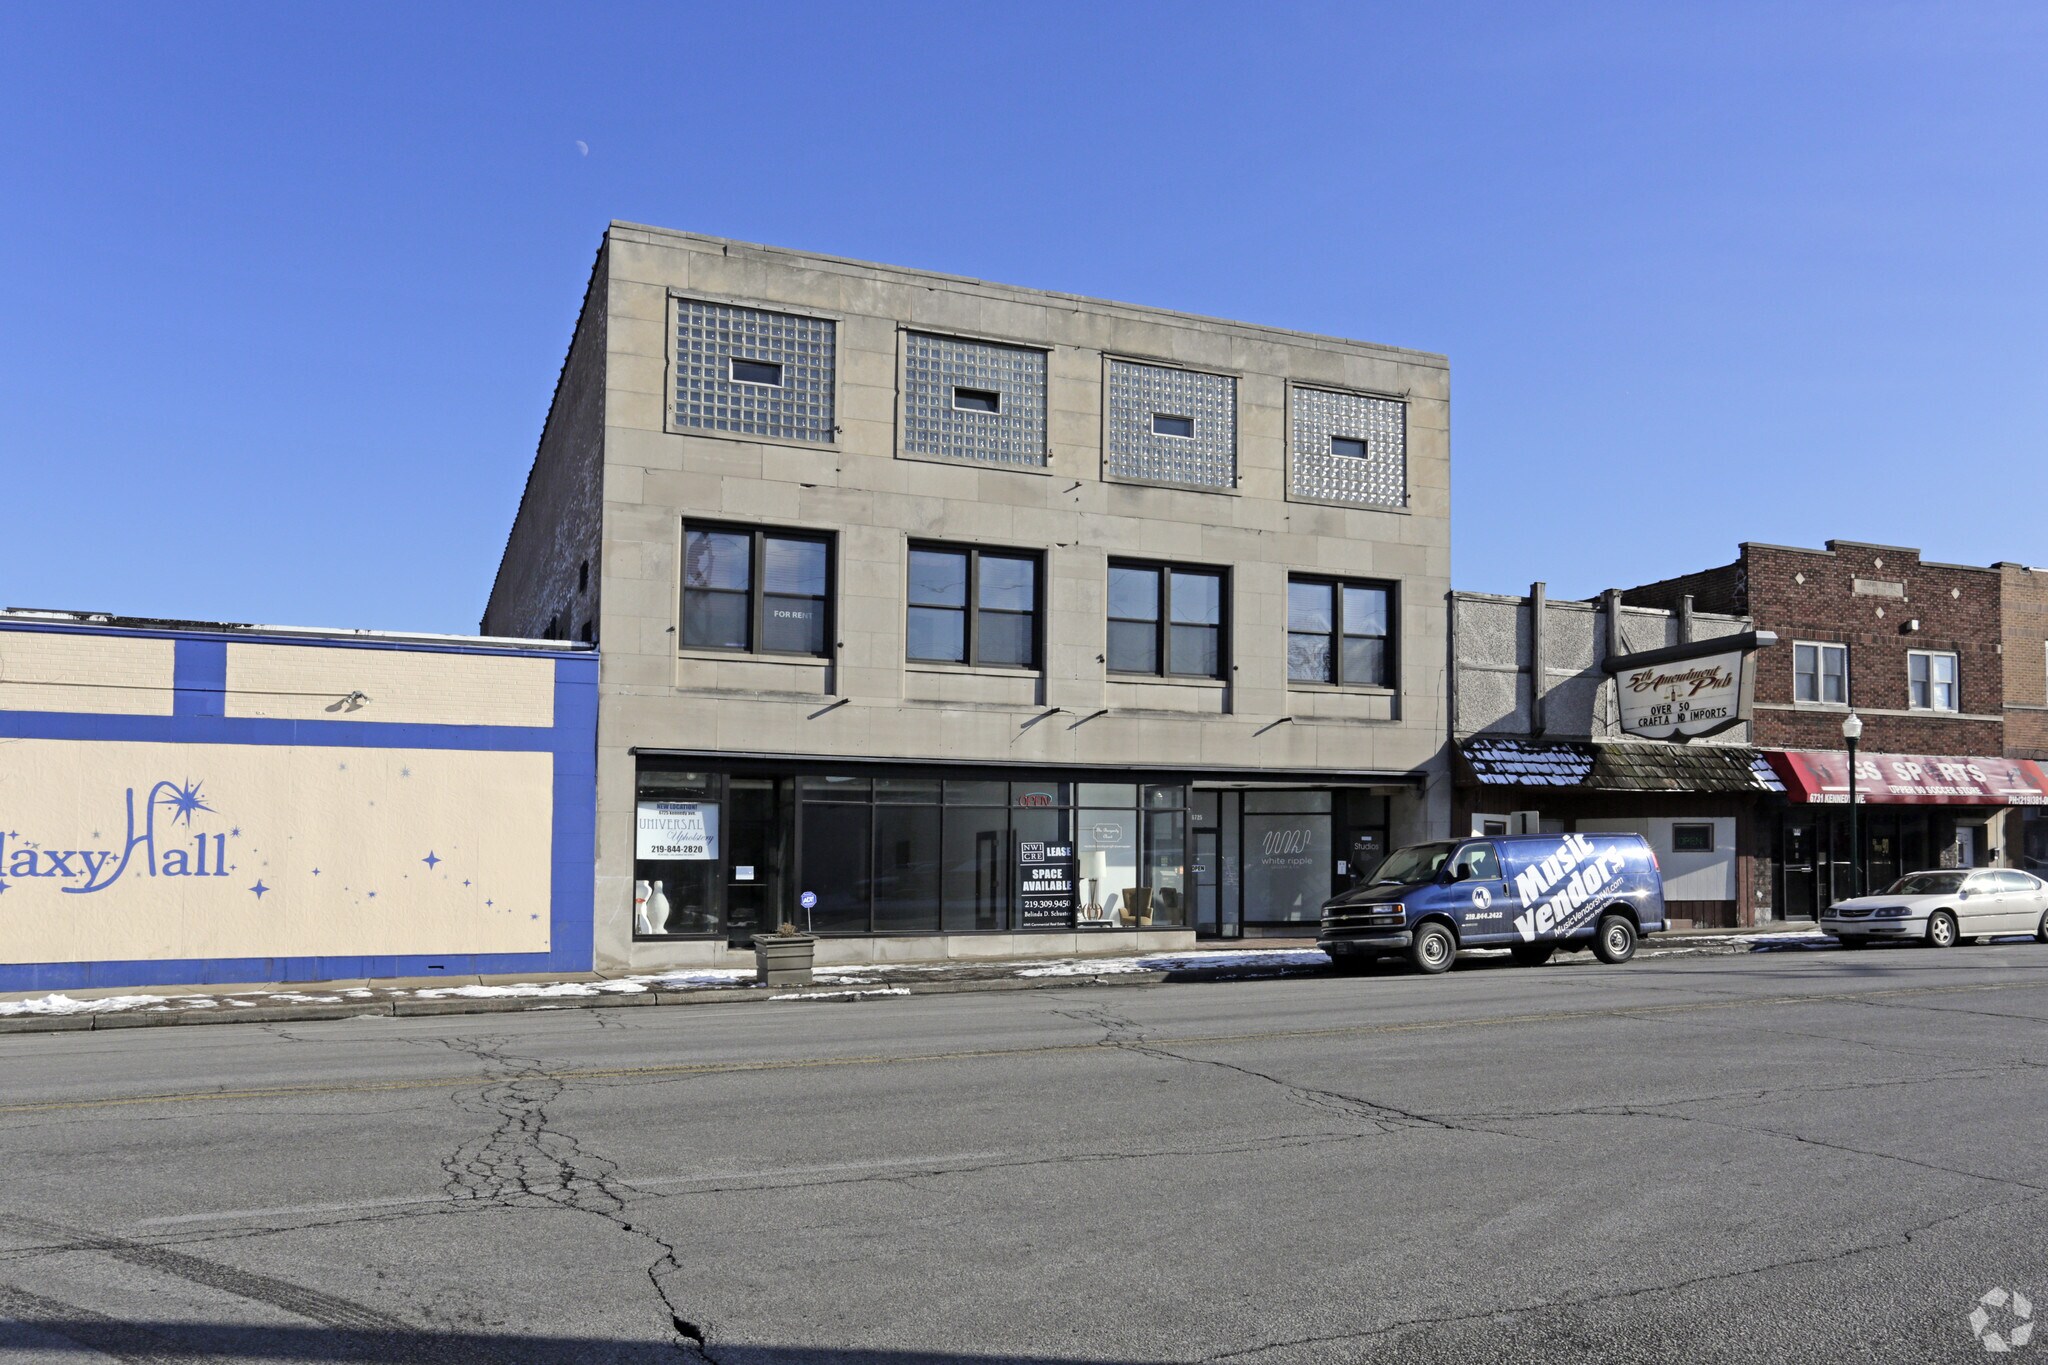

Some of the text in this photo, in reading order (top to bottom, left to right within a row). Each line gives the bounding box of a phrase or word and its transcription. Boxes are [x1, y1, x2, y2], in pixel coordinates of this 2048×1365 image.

[774, 610, 813, 620] FOR RENT
[1625, 665, 1722, 693] 5th Amendment
[1688, 672, 1733, 697] Pub
[1651, 702, 1690, 716] OVER 50
[1638, 716, 1663, 727] CRAFT
[1690, 707, 1728, 721] IMPORTS
[1888, 786, 1916, 794] UPPER
[1926, 786, 1959, 795] SOCCER
[1955, 786, 1983, 795] STORE
[1018, 795, 1049, 806] OPEN
[1810, 793, 1824, 803] 6731
[1824, 794, 1851, 804] KENNED
[639, 818, 703, 830] UNIVERSAL
[61, 780, 229, 893] Hall
[667, 830, 714, 845] Upholstery
[651, 845, 703, 854] 219-844-2820
[1046, 847, 1071, 857] LEASE
[1261, 857, 1286, 865] white
[1287, 856, 1313, 867] ripple
[1032, 869, 1063, 879] SPACE
[1514, 834, 1595, 909] Music
[1023, 881, 1072, 891] AVAILABLE
[1513, 845, 1625, 943] Vendors
[1024, 900, 1071, 908] 219.309.9450
[1465, 912, 1503, 920] 219.844.2422
